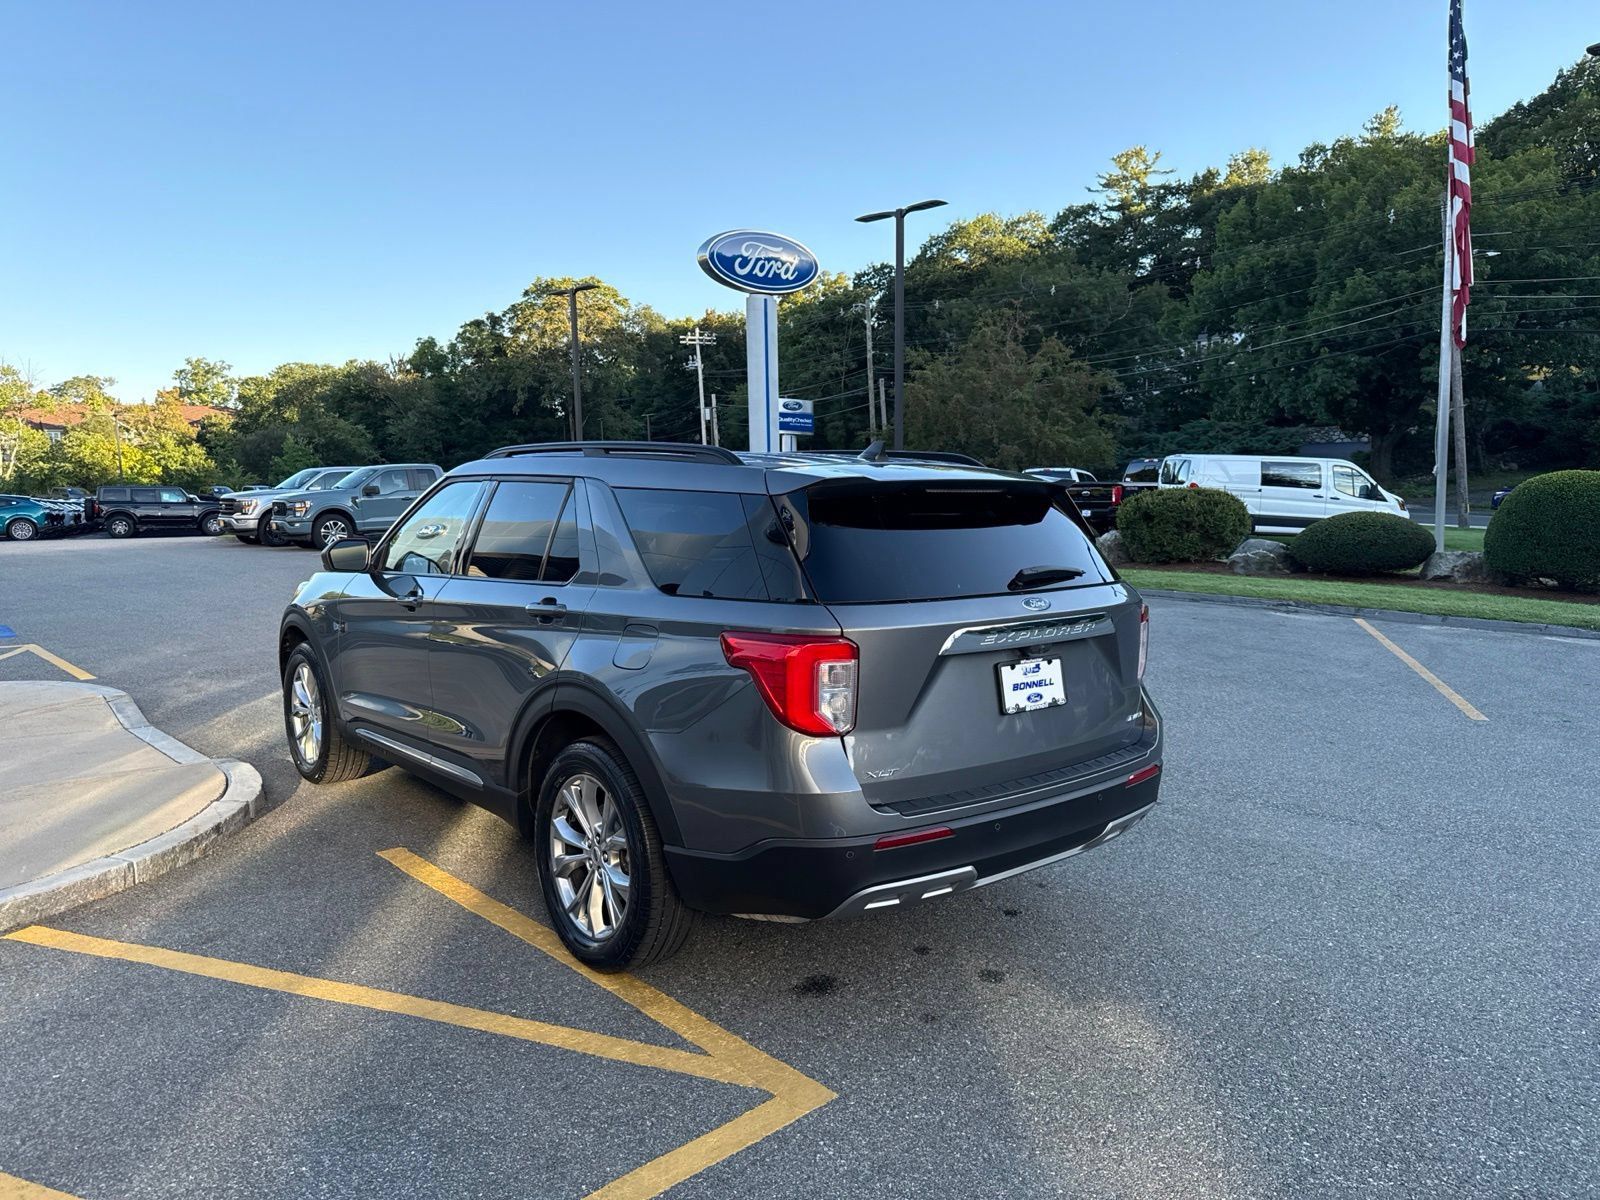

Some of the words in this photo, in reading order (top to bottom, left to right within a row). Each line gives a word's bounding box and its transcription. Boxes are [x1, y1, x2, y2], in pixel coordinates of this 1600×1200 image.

[734, 241, 799, 280] Ford
[981, 623, 1096, 645] EXPLORER
[1012, 678, 1054, 691] BONNELL
[864, 767, 900, 779] XLT
